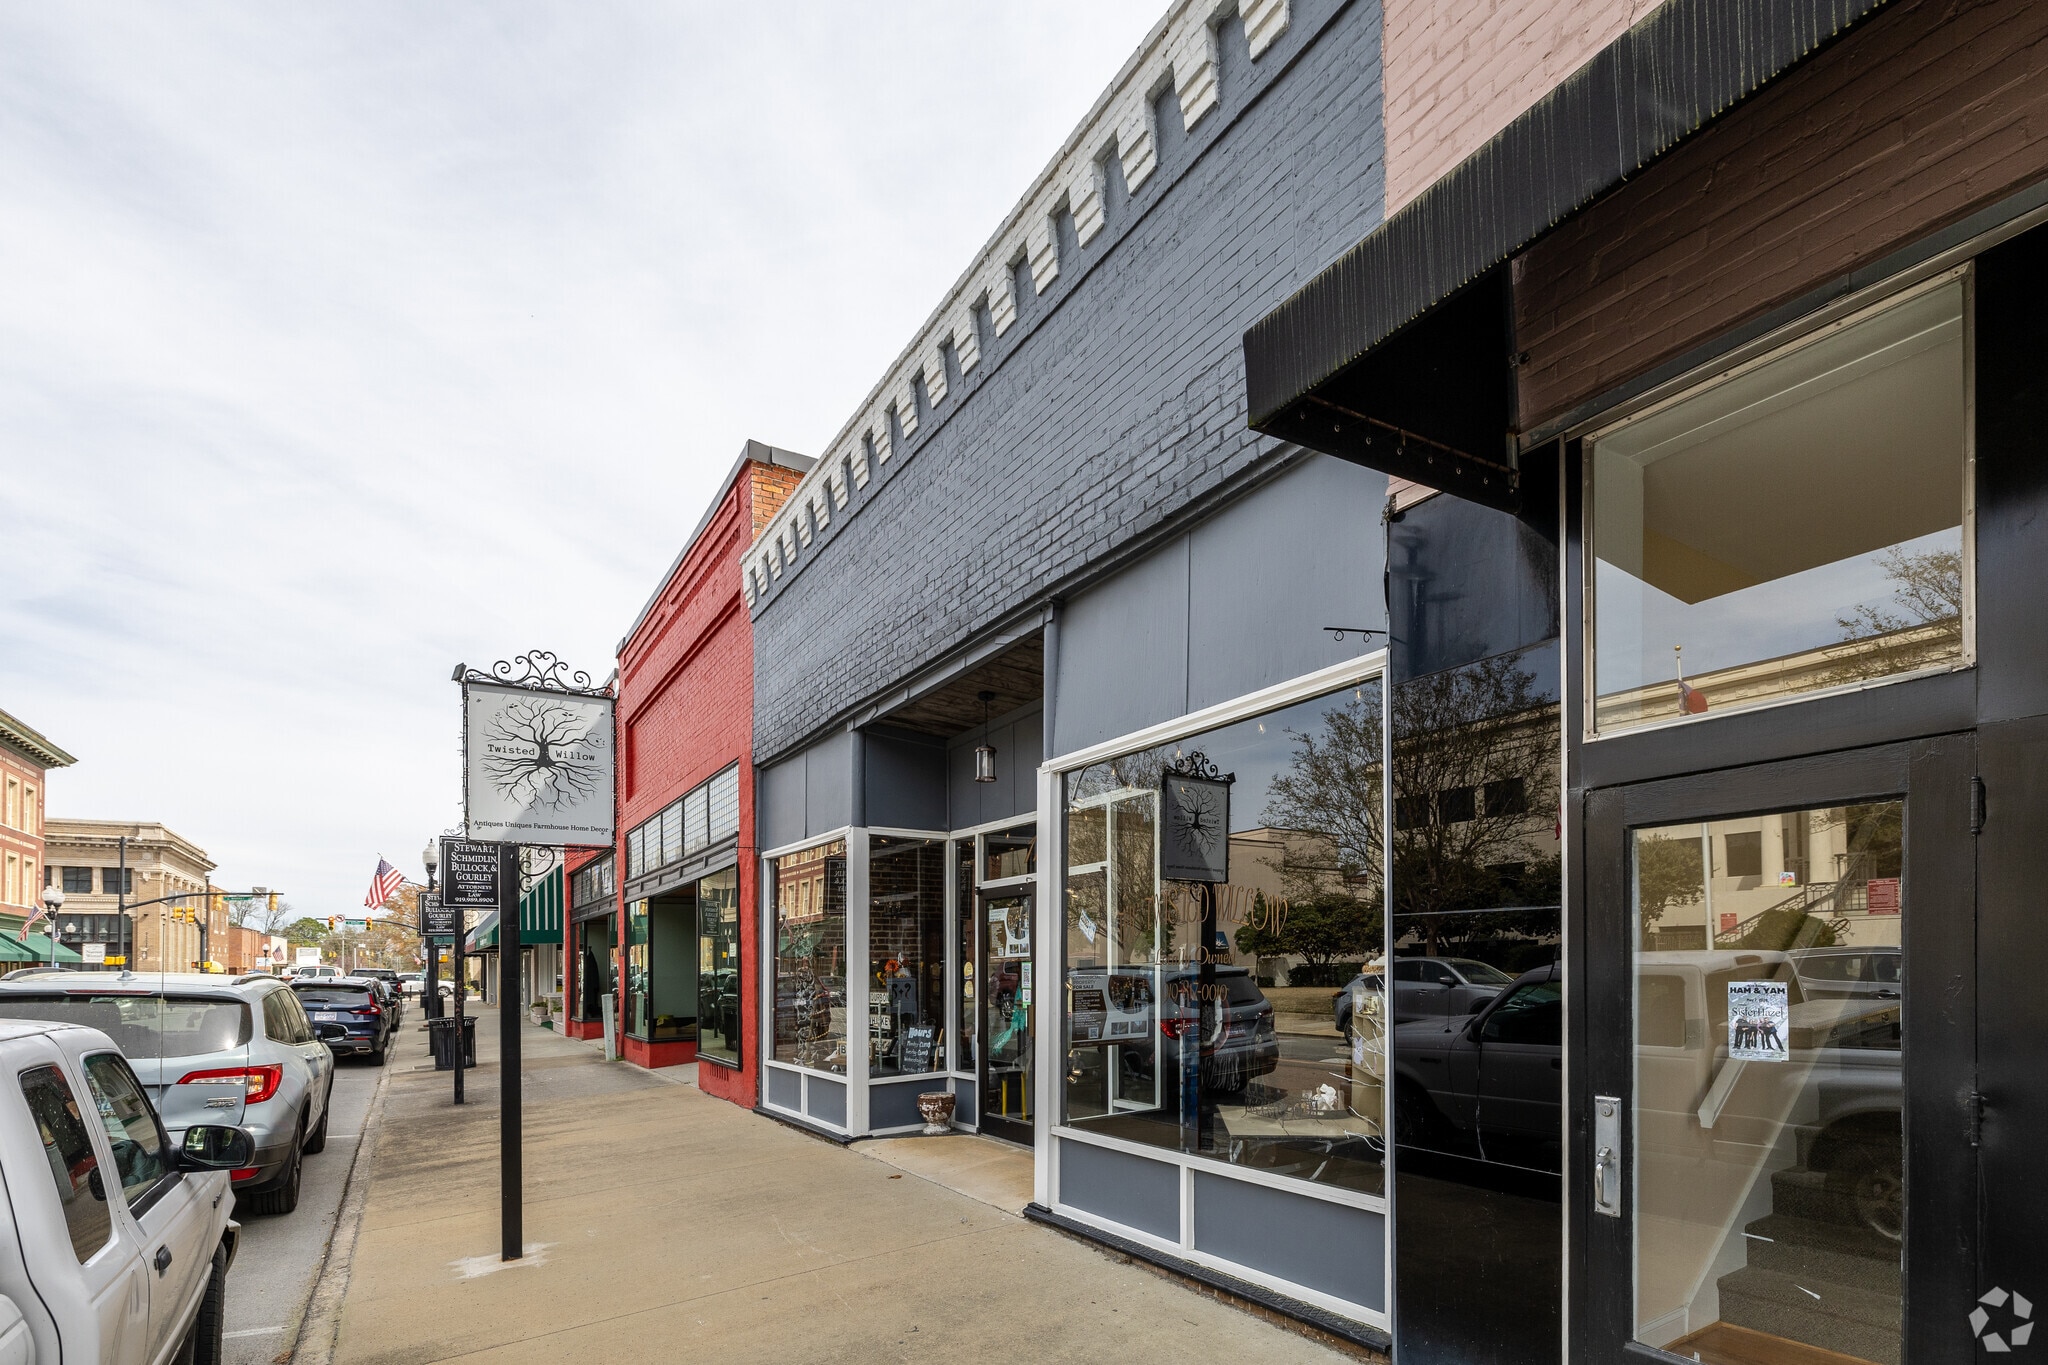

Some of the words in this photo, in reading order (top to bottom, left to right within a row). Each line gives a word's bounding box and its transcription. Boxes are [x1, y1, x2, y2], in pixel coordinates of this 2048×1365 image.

[488, 744, 535, 756] Twisted
[556, 750, 596, 761] Willow
[473, 820, 504, 829] Antiques
[505, 821, 533, 830] Uniques
[533, 823, 570, 831] Farmhouse
[590, 826, 609, 834] Decor
[454, 843, 495, 854] STEWART,
[451, 852, 498, 864] SCHMIDLIN,
[456, 872, 493, 882] GOURLEY
[1212, 883, 1288, 937] WILLOW
[1195, 946, 1236, 965] Owned
[908, 1026, 932, 1039] Hours
